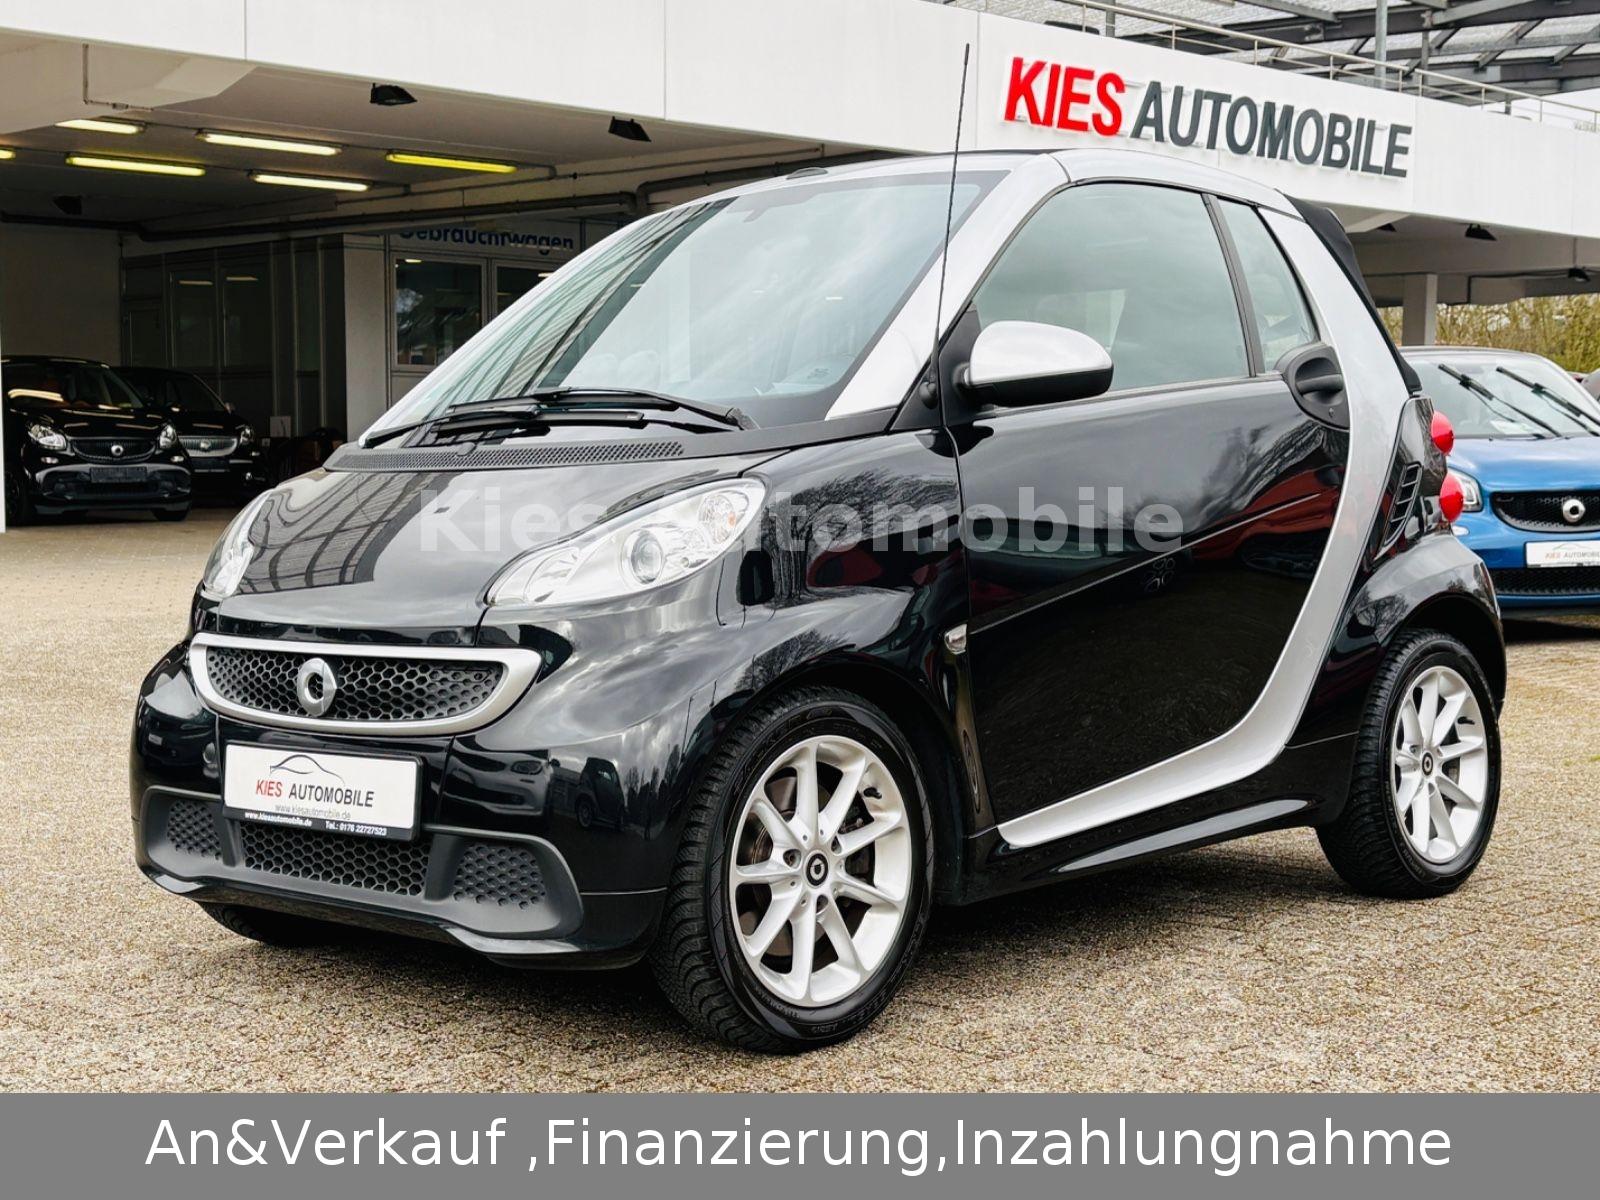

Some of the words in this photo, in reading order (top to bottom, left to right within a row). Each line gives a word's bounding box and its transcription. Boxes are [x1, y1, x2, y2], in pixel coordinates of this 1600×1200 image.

[1004, 57, 1126, 136] KIES
[1130, 81, 1413, 178] AUTOMOBILE
[256, 779, 283, 797] KIES
[289, 783, 375, 808] AUTOMOBILE
